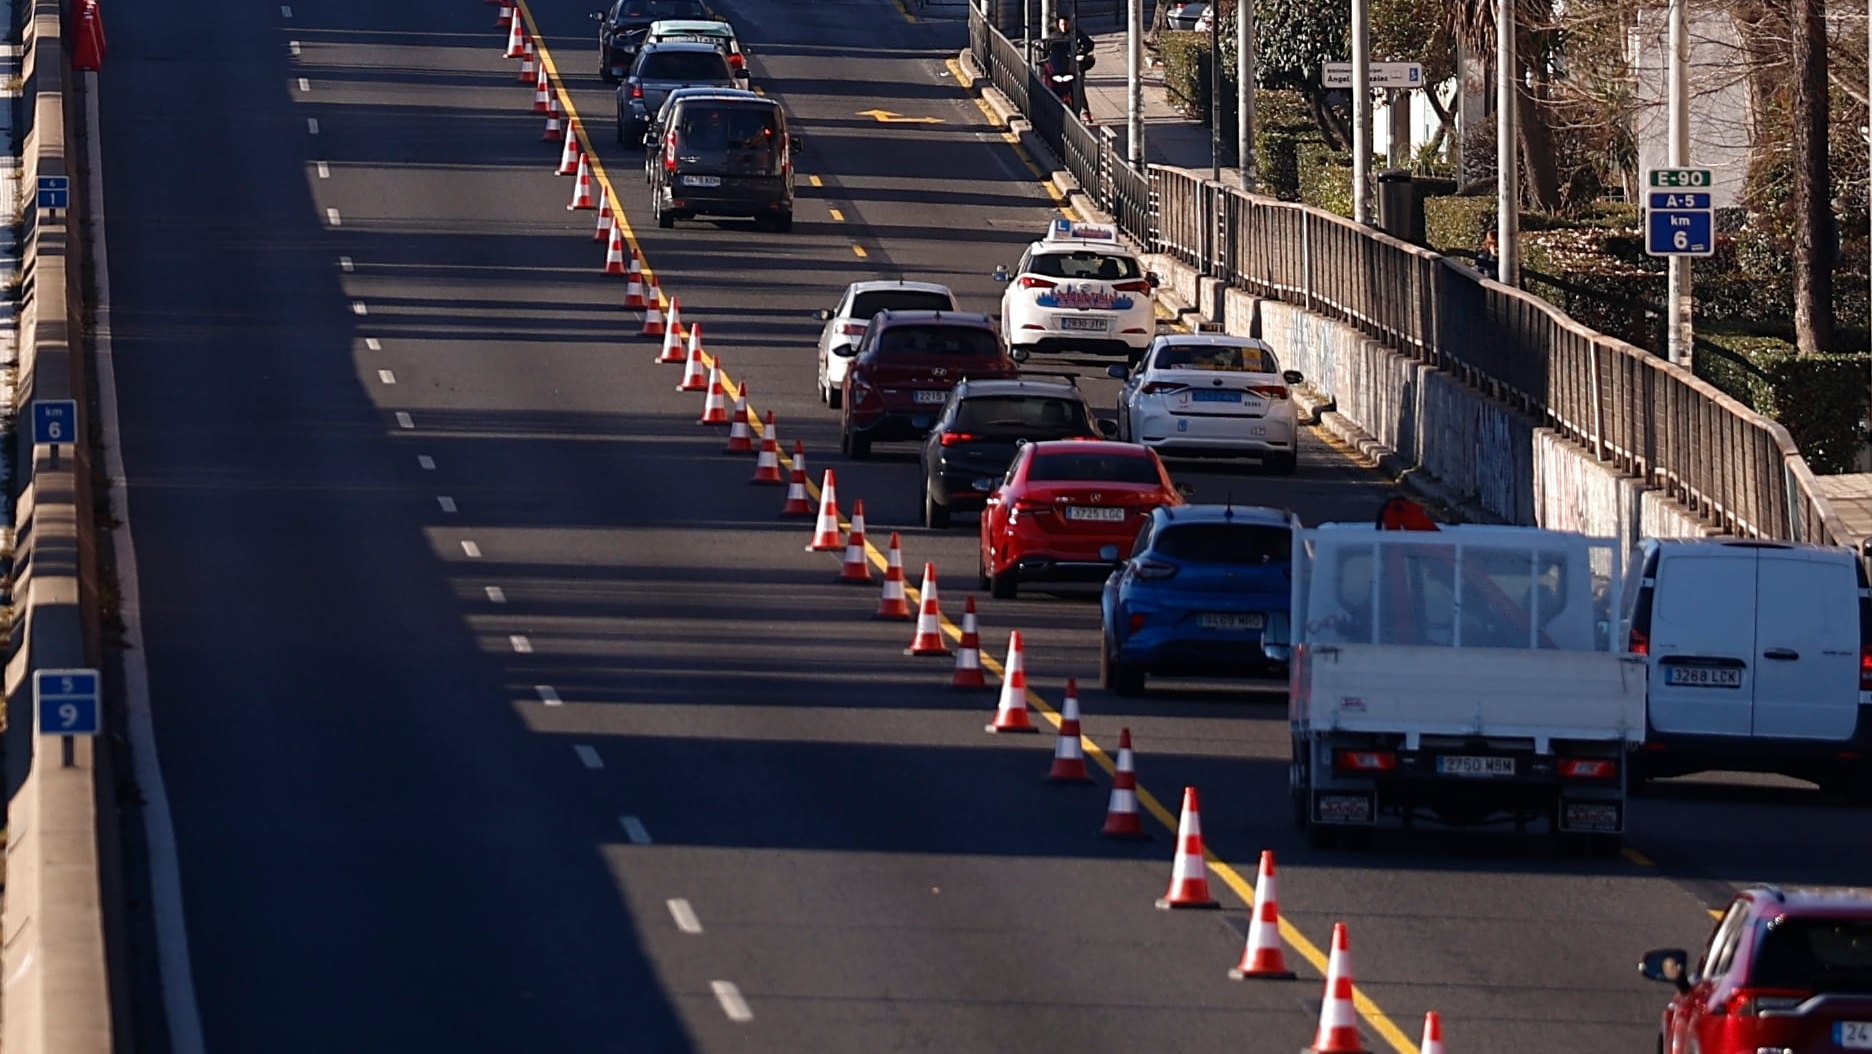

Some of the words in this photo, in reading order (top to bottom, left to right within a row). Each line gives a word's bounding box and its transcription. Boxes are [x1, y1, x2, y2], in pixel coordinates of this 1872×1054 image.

[49, 180, 56, 188] 6
[1658, 171, 1703, 186] E-90
[50, 193, 56, 205] 1
[1666, 194, 1695, 207] A-5
[1057, 221, 1066, 230] L
[1670, 214, 1690, 226] km
[1673, 230, 1688, 250] 6
[45, 407, 63, 417] km
[48, 421, 61, 438] 6
[1674, 669, 1707, 682] 3268
[1711, 670, 1736, 683] LCK
[61, 677, 73, 692] 5
[58, 703, 77, 727] 9
[1847, 1024, 1867, 1041] 24
